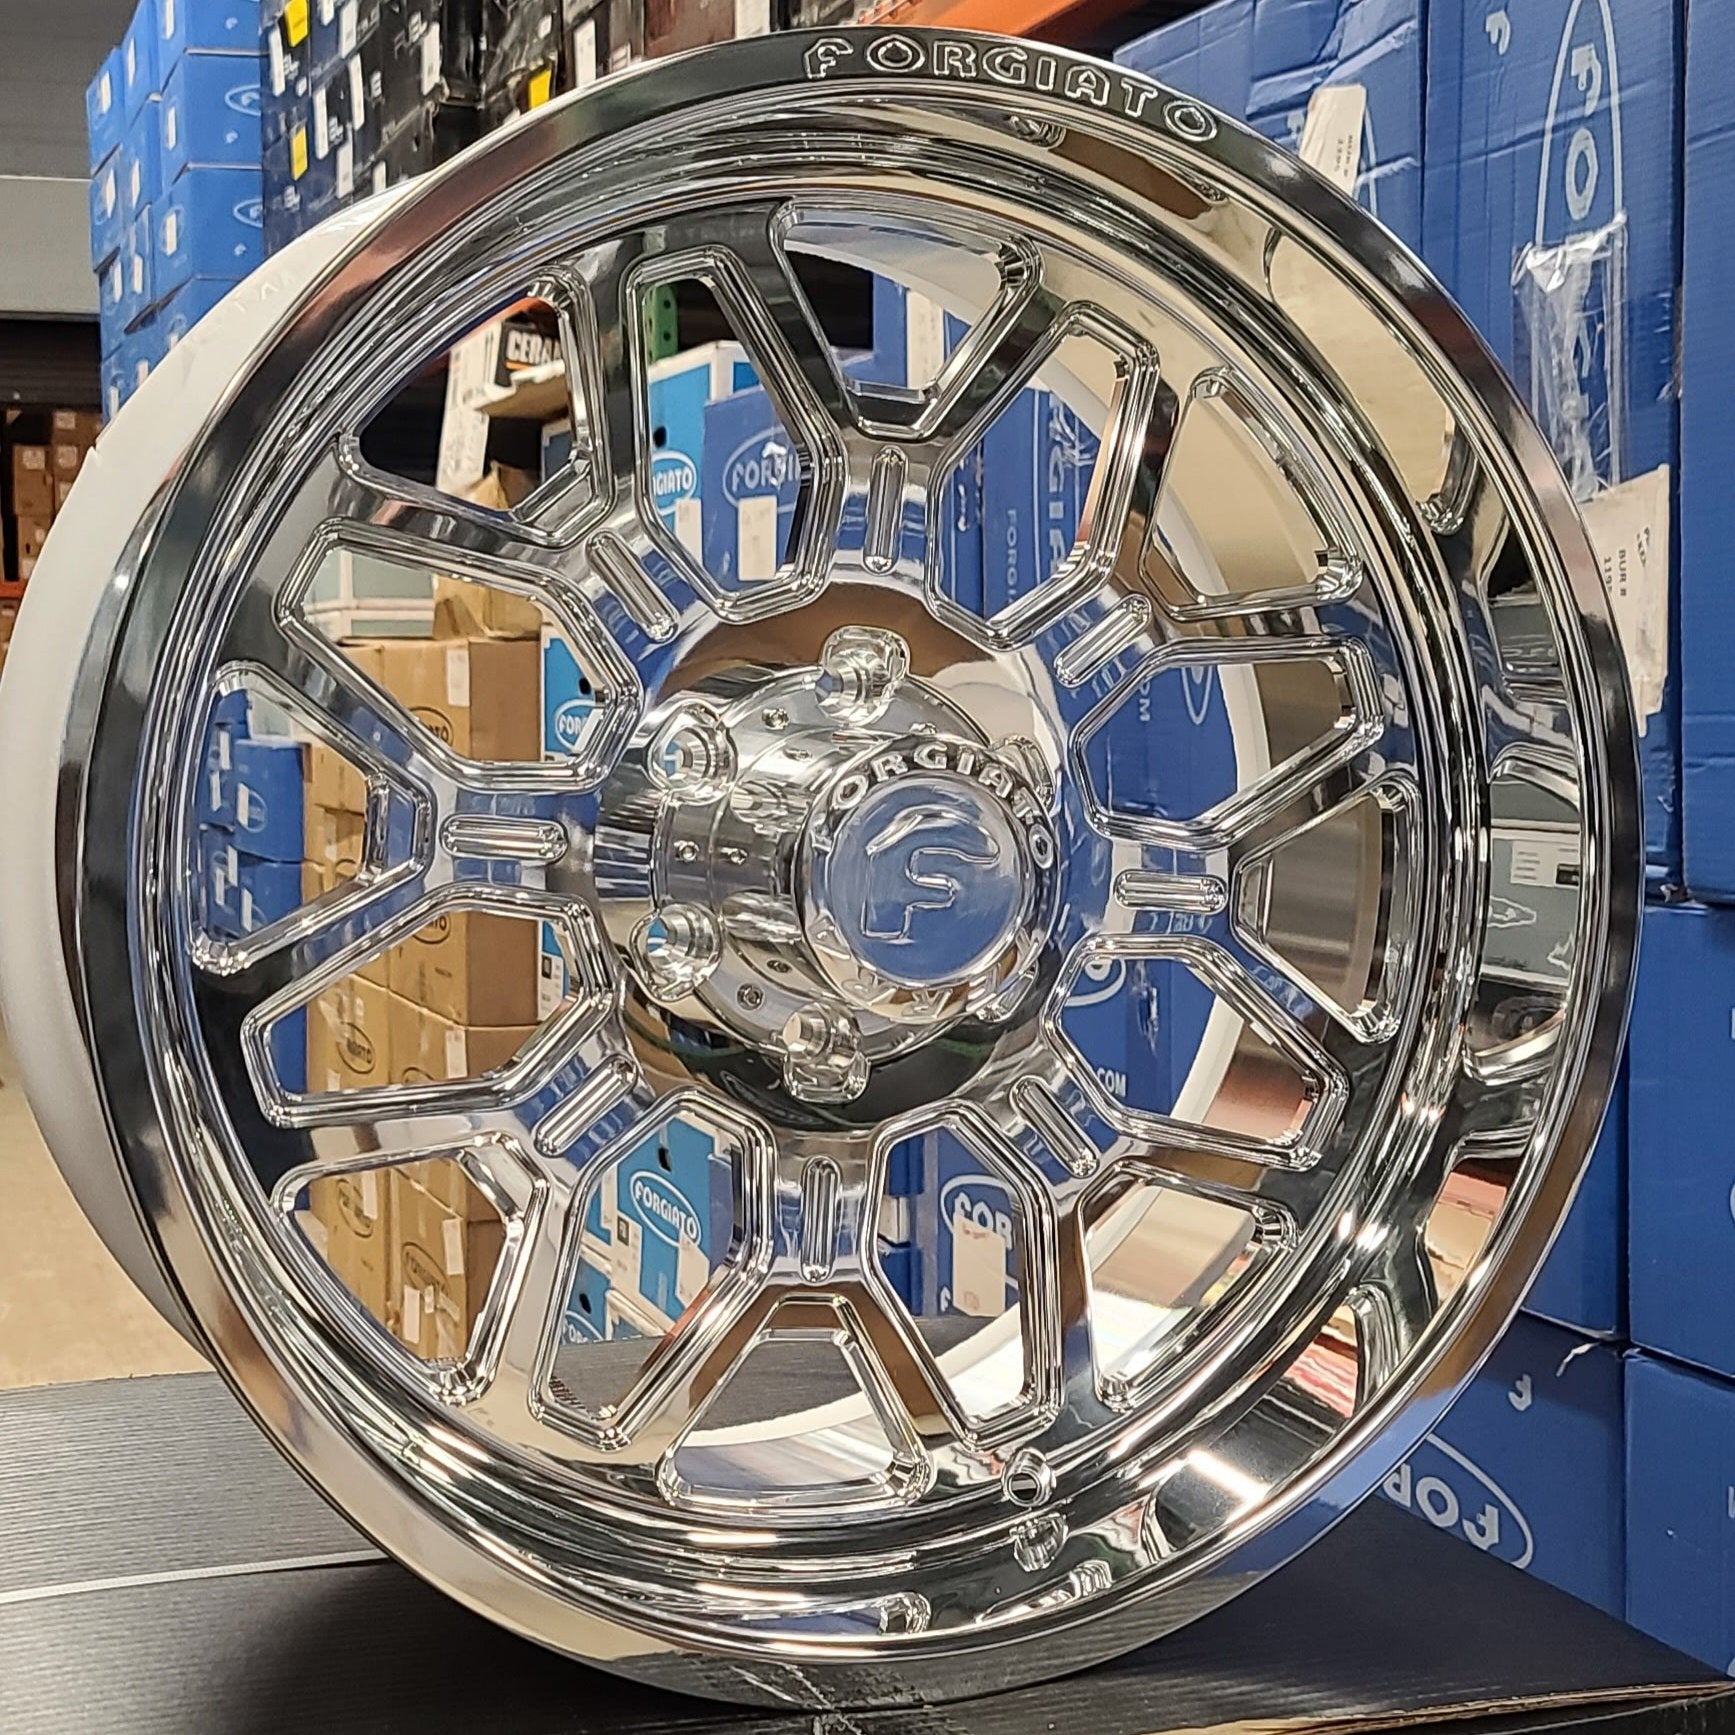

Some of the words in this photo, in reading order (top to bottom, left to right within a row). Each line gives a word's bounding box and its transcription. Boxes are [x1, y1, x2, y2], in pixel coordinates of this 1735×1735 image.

[803, 34, 1219, 142] FORGIATO
[1007, 508, 1018, 604] FORGI
[1617, 549, 1628, 583] BUR
[811, 740, 1053, 869] FORGIATO
[860, 802, 1000, 944] F
[634, 1179, 699, 1241] FORGIATO
